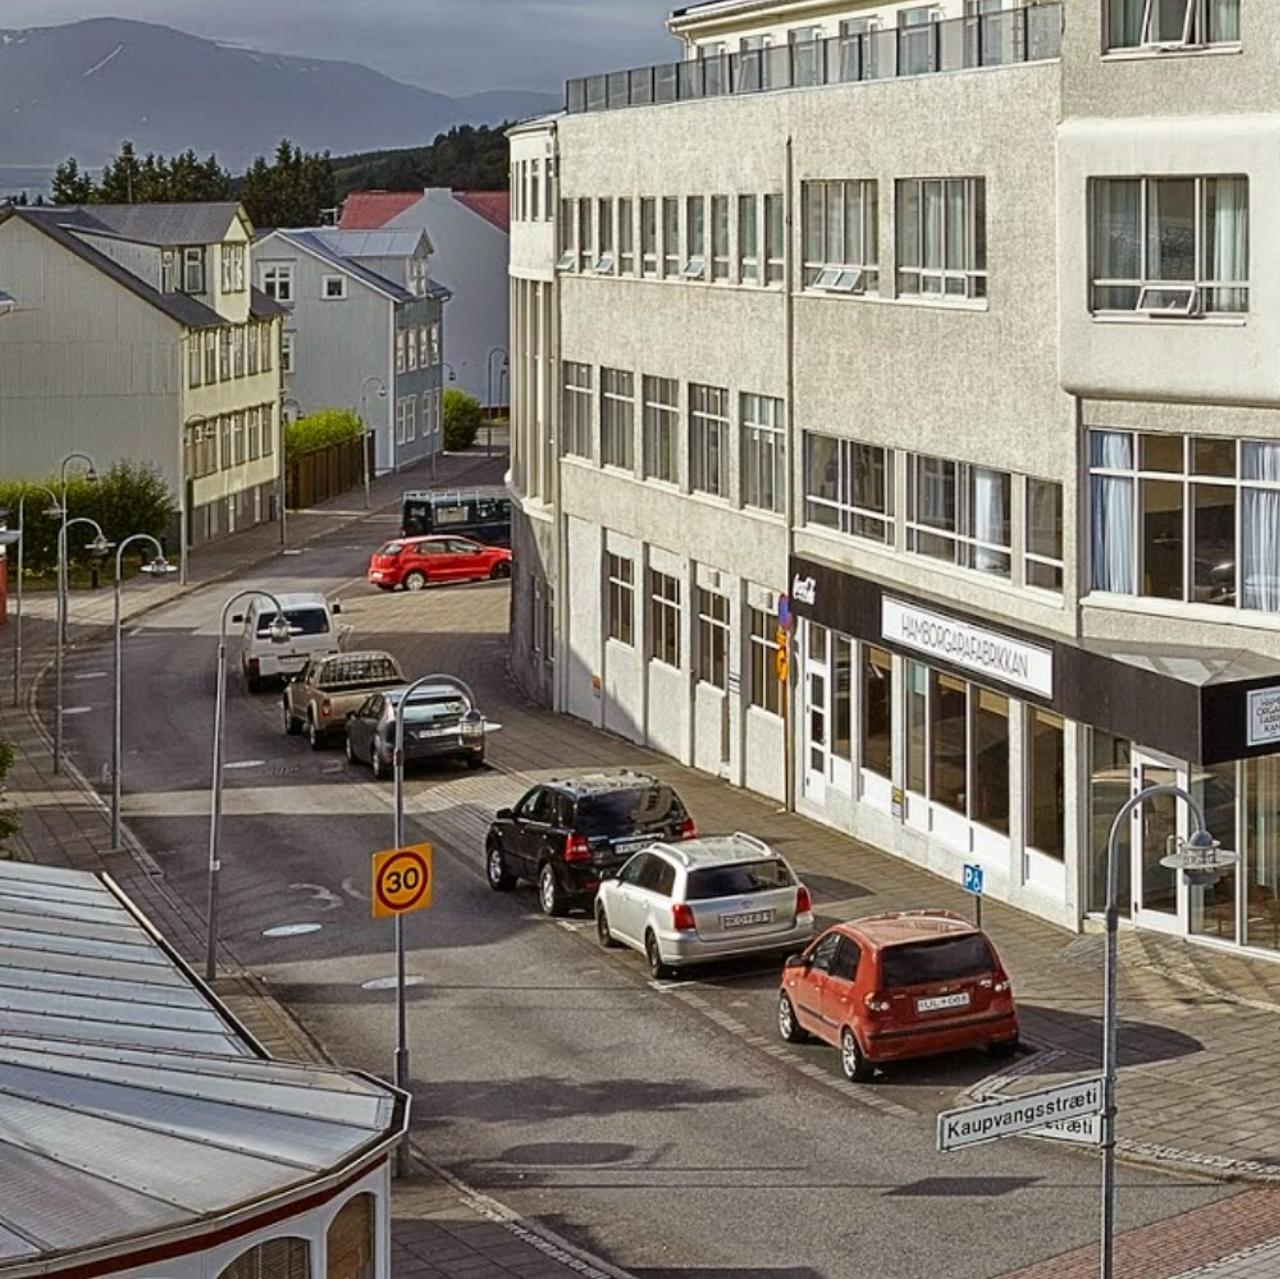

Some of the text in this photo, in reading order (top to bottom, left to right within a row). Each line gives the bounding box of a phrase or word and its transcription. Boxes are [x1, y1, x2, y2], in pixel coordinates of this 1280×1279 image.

[386, 866, 419, 894] 30
[965, 867, 973, 887] P
[947, 1088, 1097, 1139] Kaupvangsstræti
